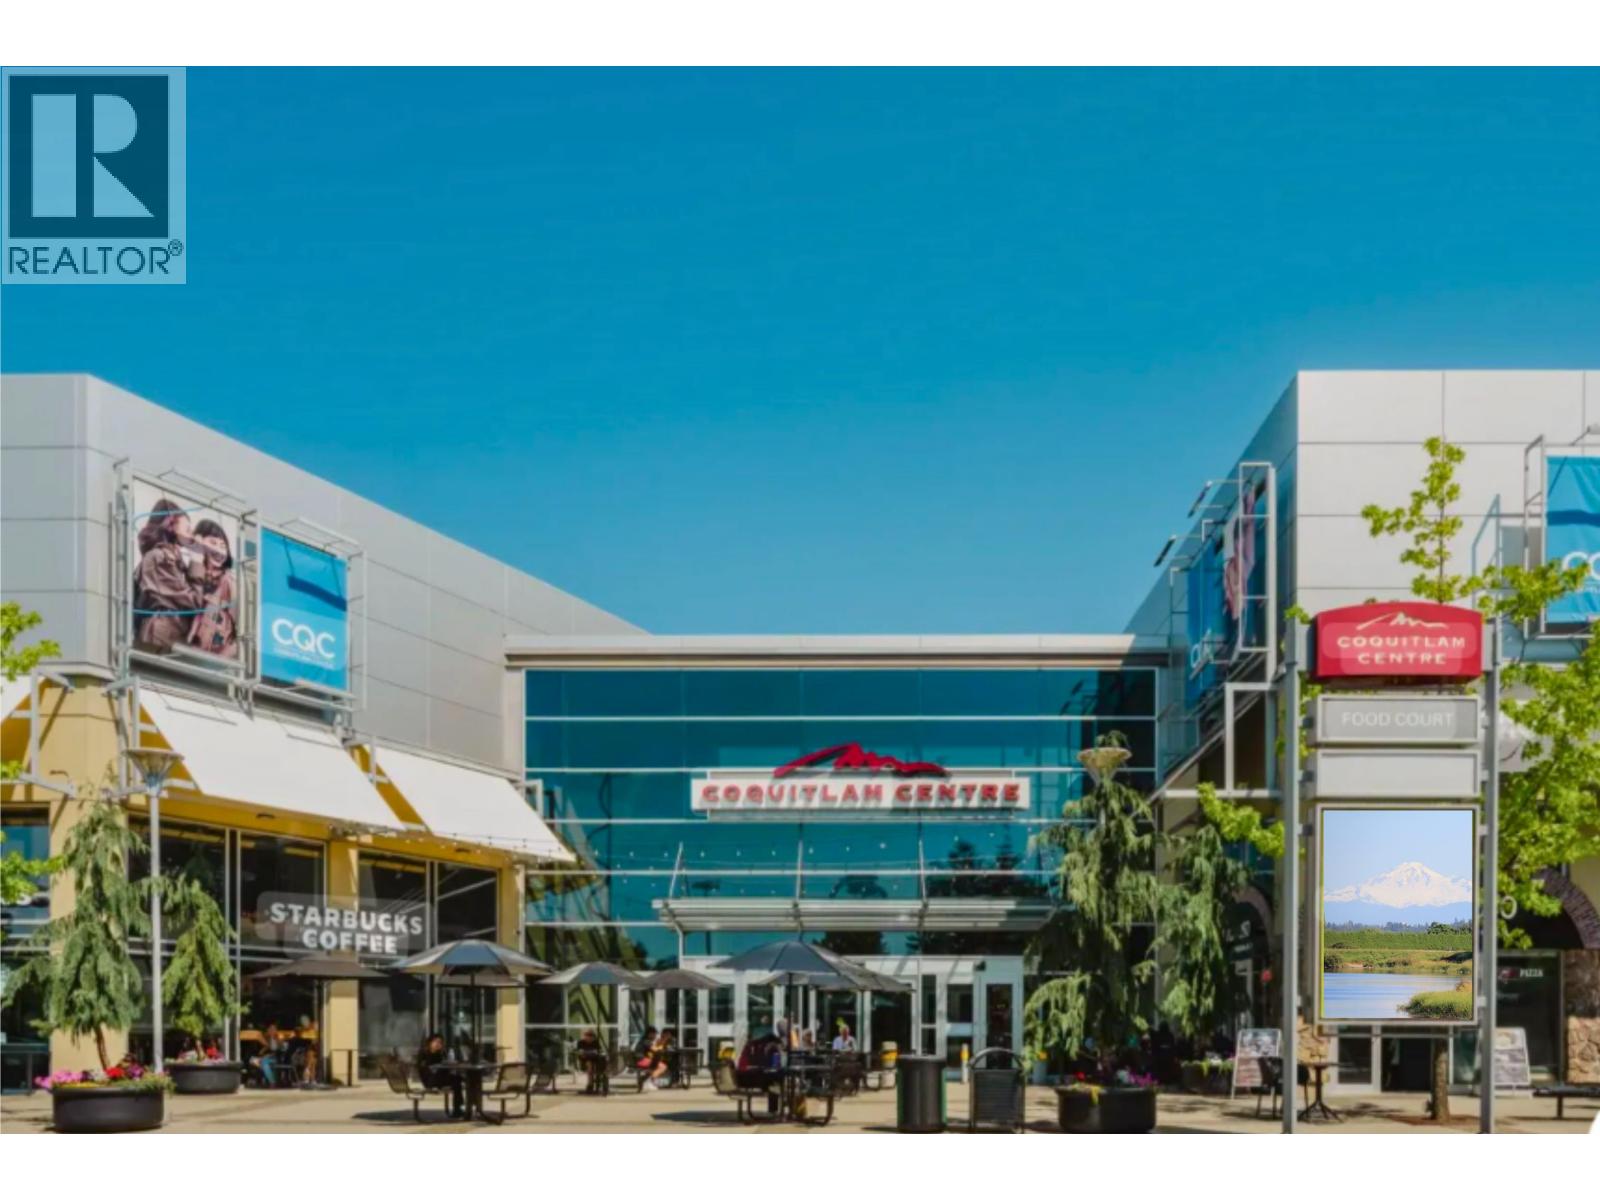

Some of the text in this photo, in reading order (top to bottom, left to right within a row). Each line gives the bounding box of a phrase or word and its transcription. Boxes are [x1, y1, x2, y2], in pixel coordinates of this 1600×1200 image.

[271, 618, 335, 659] CQC
[1337, 635, 1466, 649] COQUITLAM
[1357, 651, 1447, 665] CENTRE
[1341, 712, 1455, 727] FOOD COURT
[701, 783, 1021, 805] COQUITLAM CENTRE
[269, 902, 423, 936] STARBUCKS
[302, 928, 399, 955] COFFEE
